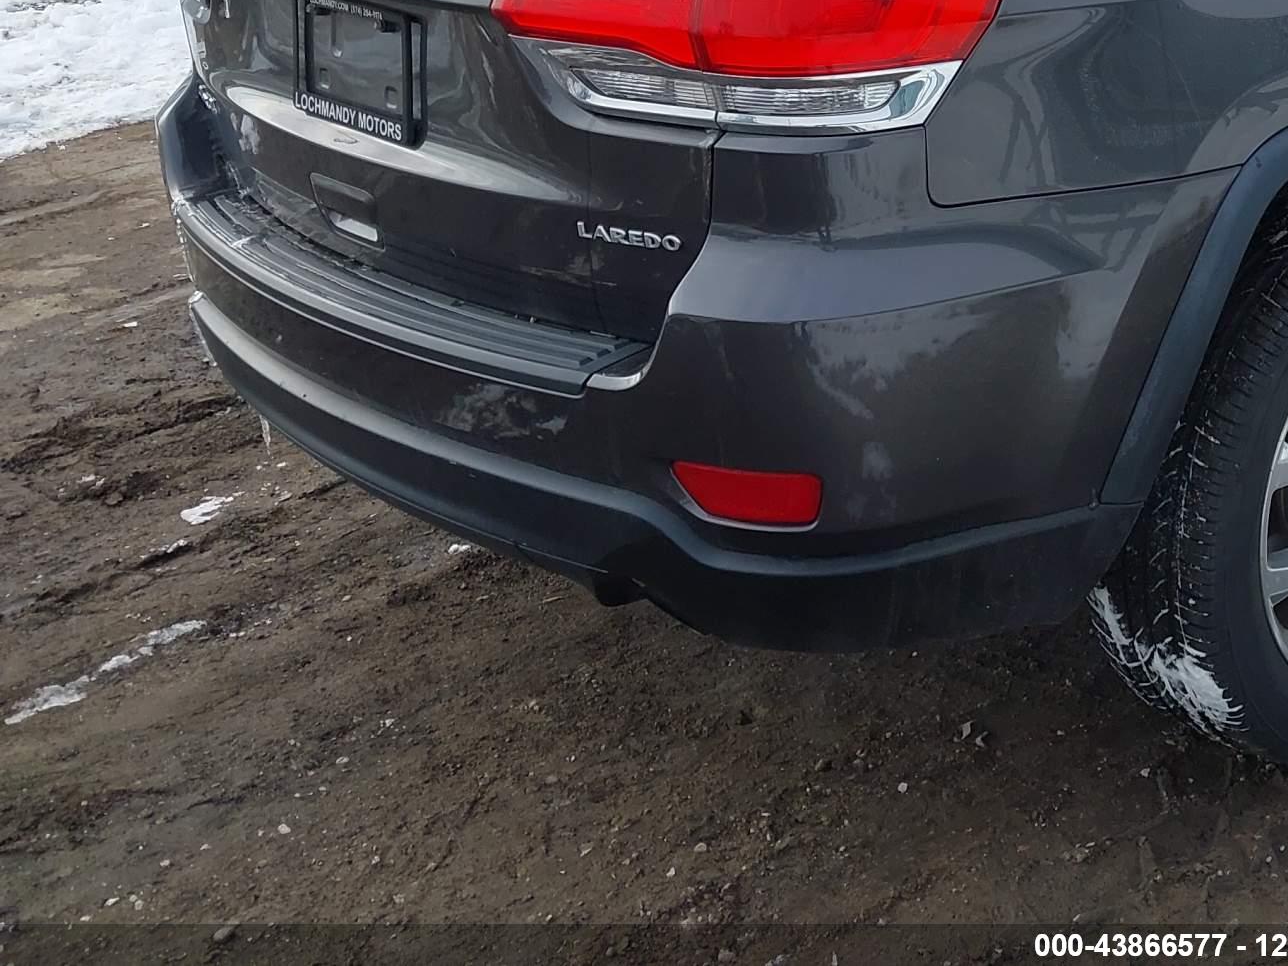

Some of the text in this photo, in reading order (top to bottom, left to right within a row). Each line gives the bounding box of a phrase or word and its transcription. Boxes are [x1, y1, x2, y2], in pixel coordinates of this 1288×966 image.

[295, 91, 402, 141] LOCHMANDY MOTORS
[576, 220, 682, 252] LAREDO
